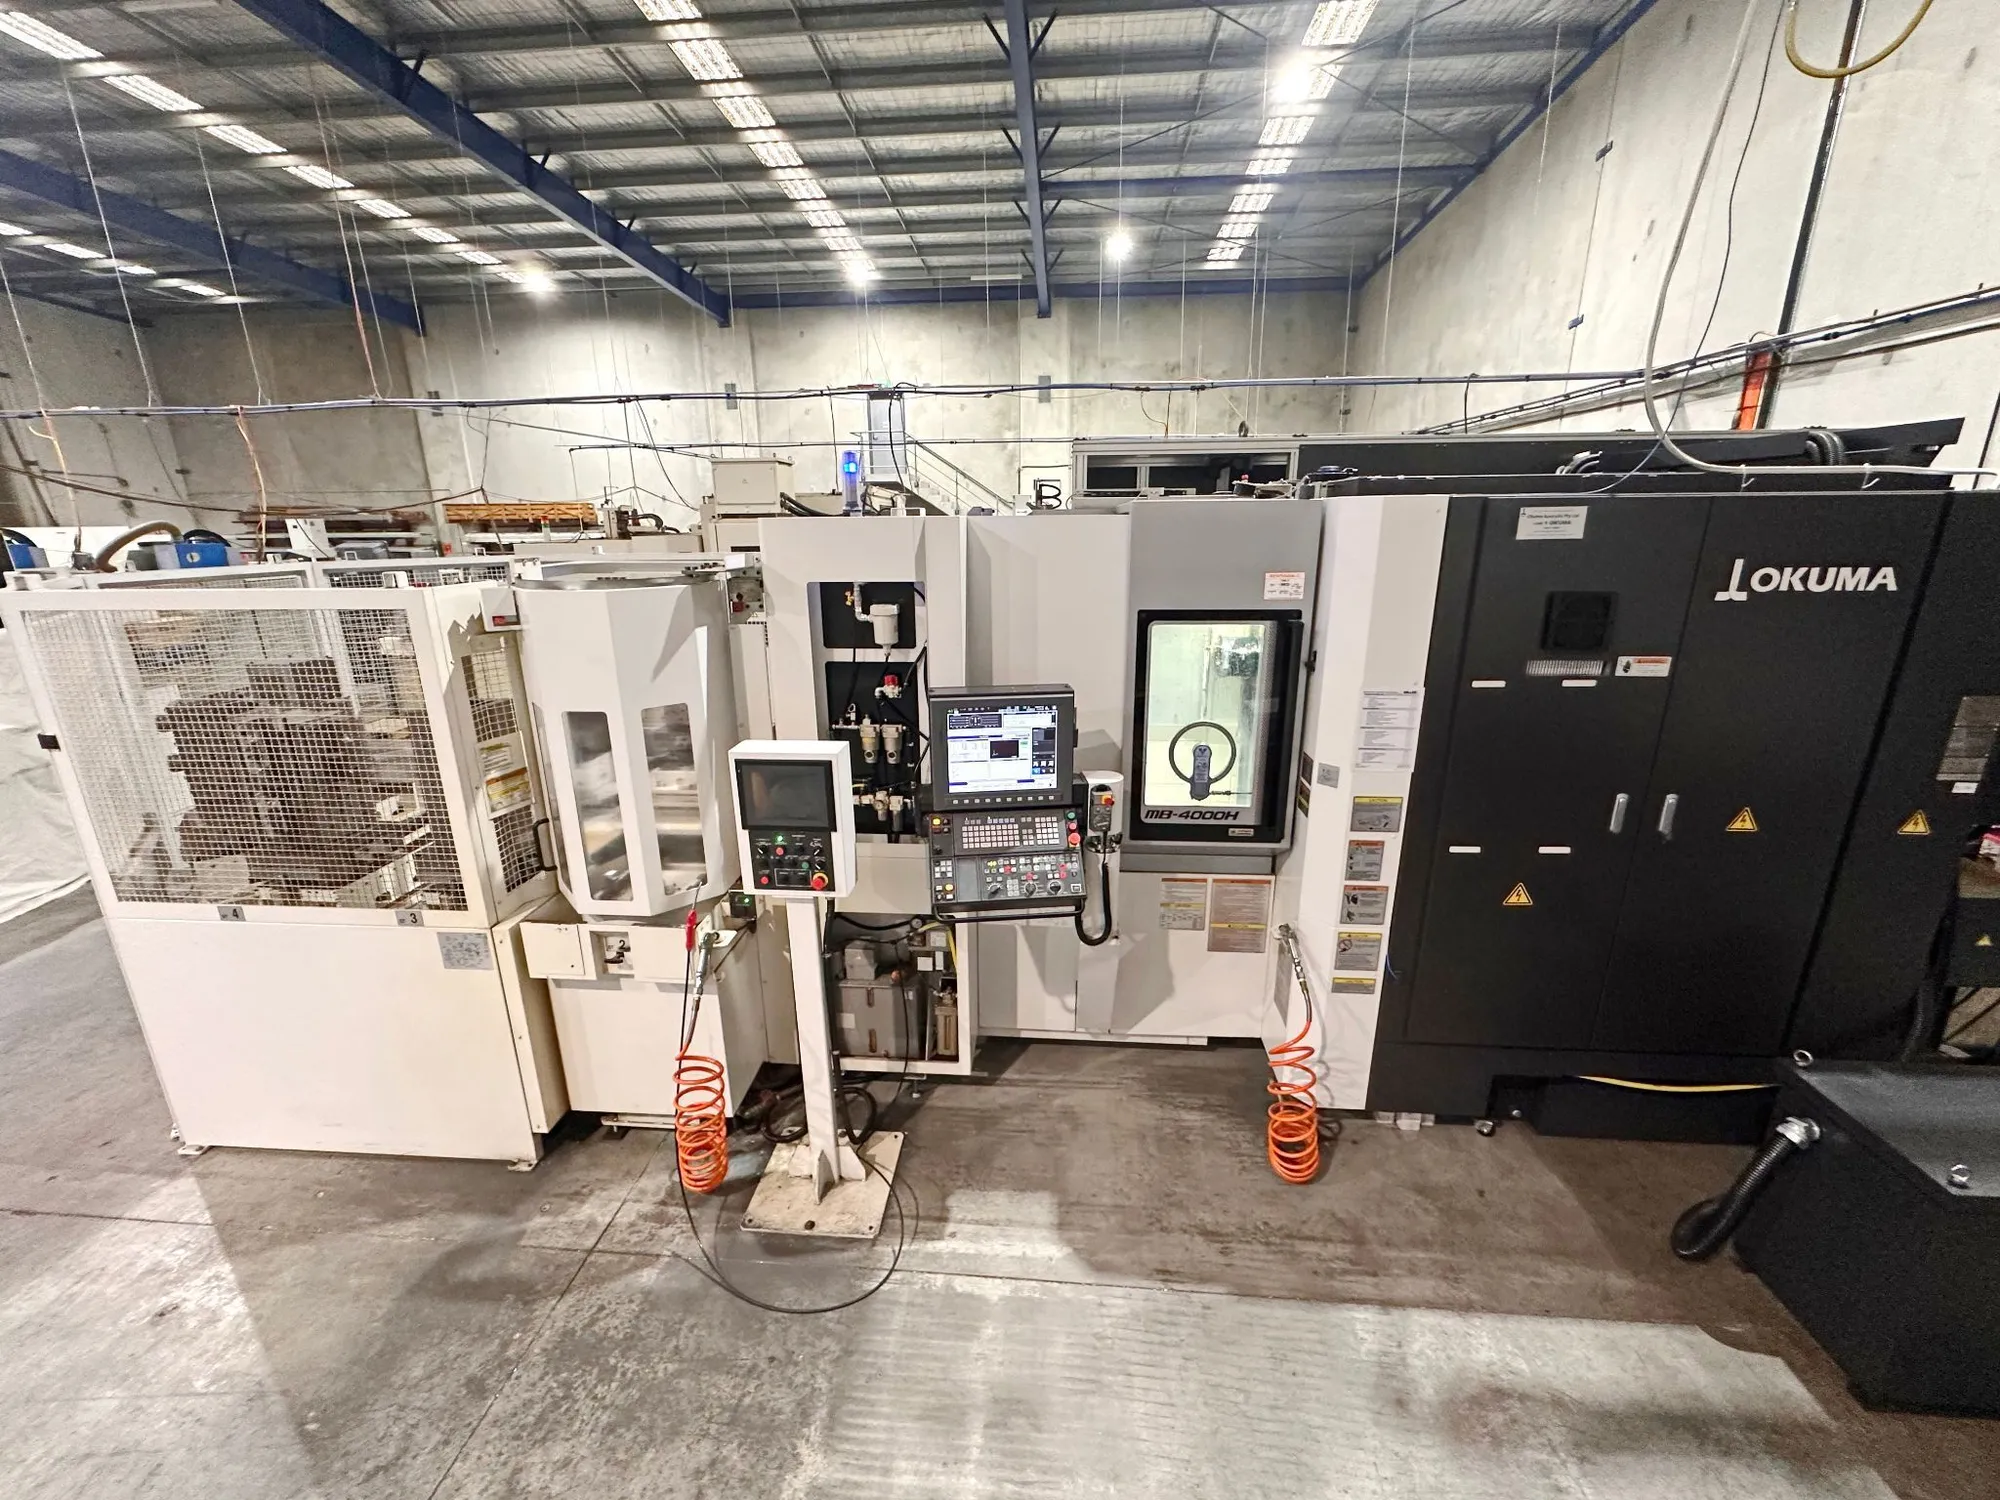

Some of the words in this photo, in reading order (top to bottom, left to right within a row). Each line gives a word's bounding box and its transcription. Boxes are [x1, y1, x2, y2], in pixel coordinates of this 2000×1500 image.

[1750, 566, 1898, 593] OKUMA
[1144, 809, 1240, 821] MB-4000H
[232, 908, 239, 919] 4
[409, 912, 418, 924] 3
[618, 939, 626, 950] 2
